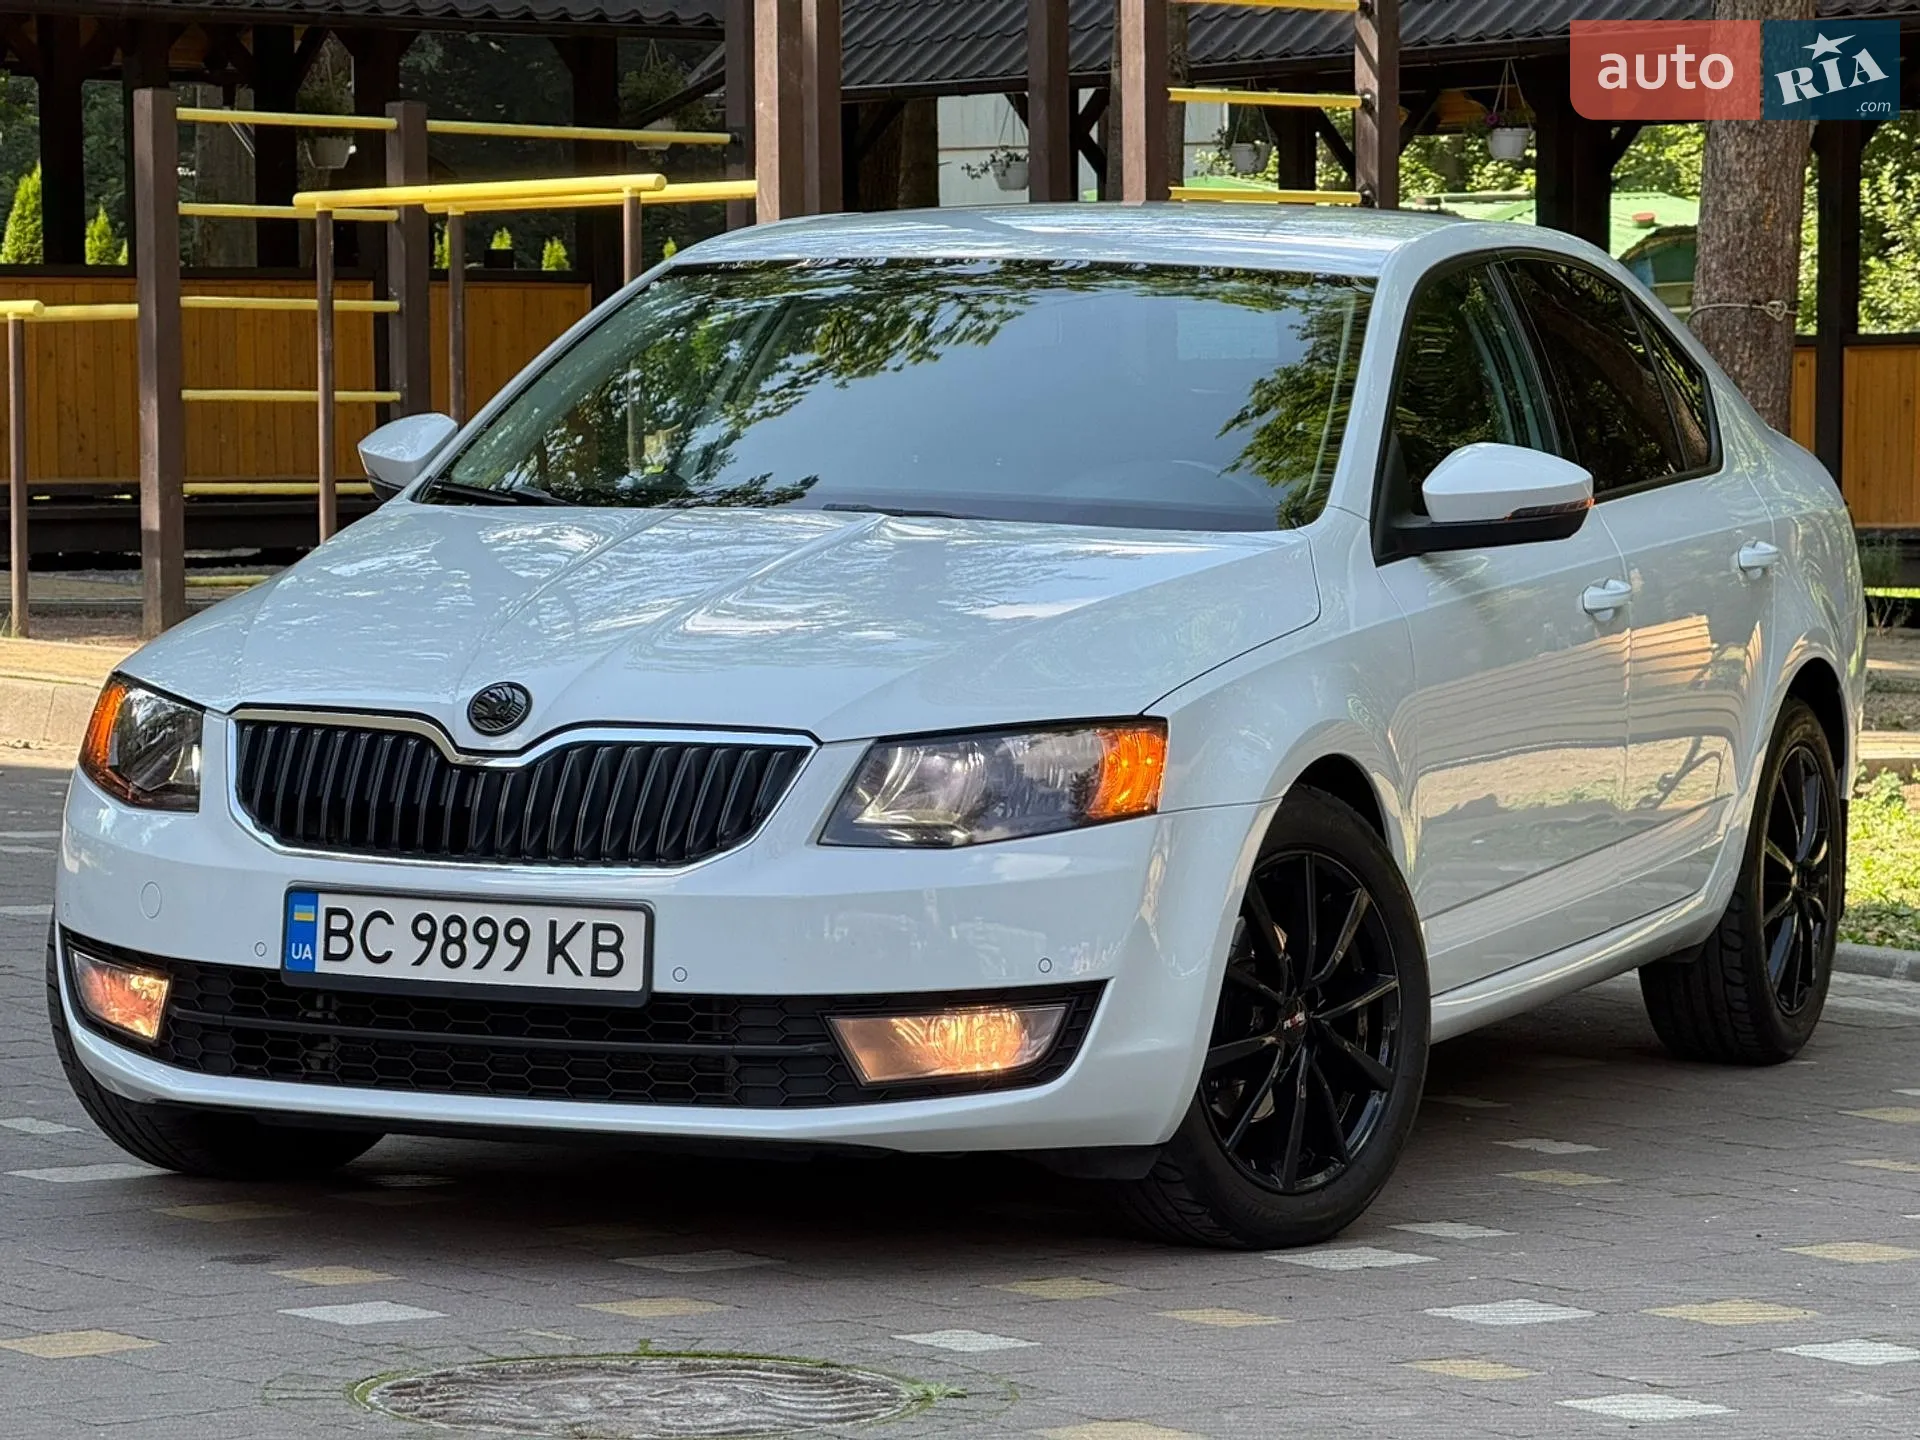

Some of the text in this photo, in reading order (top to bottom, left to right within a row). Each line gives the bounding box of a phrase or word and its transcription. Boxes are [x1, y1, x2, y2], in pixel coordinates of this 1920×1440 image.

[291, 943, 312, 961] UA
[323, 906, 625, 977] BC 9899 KB
